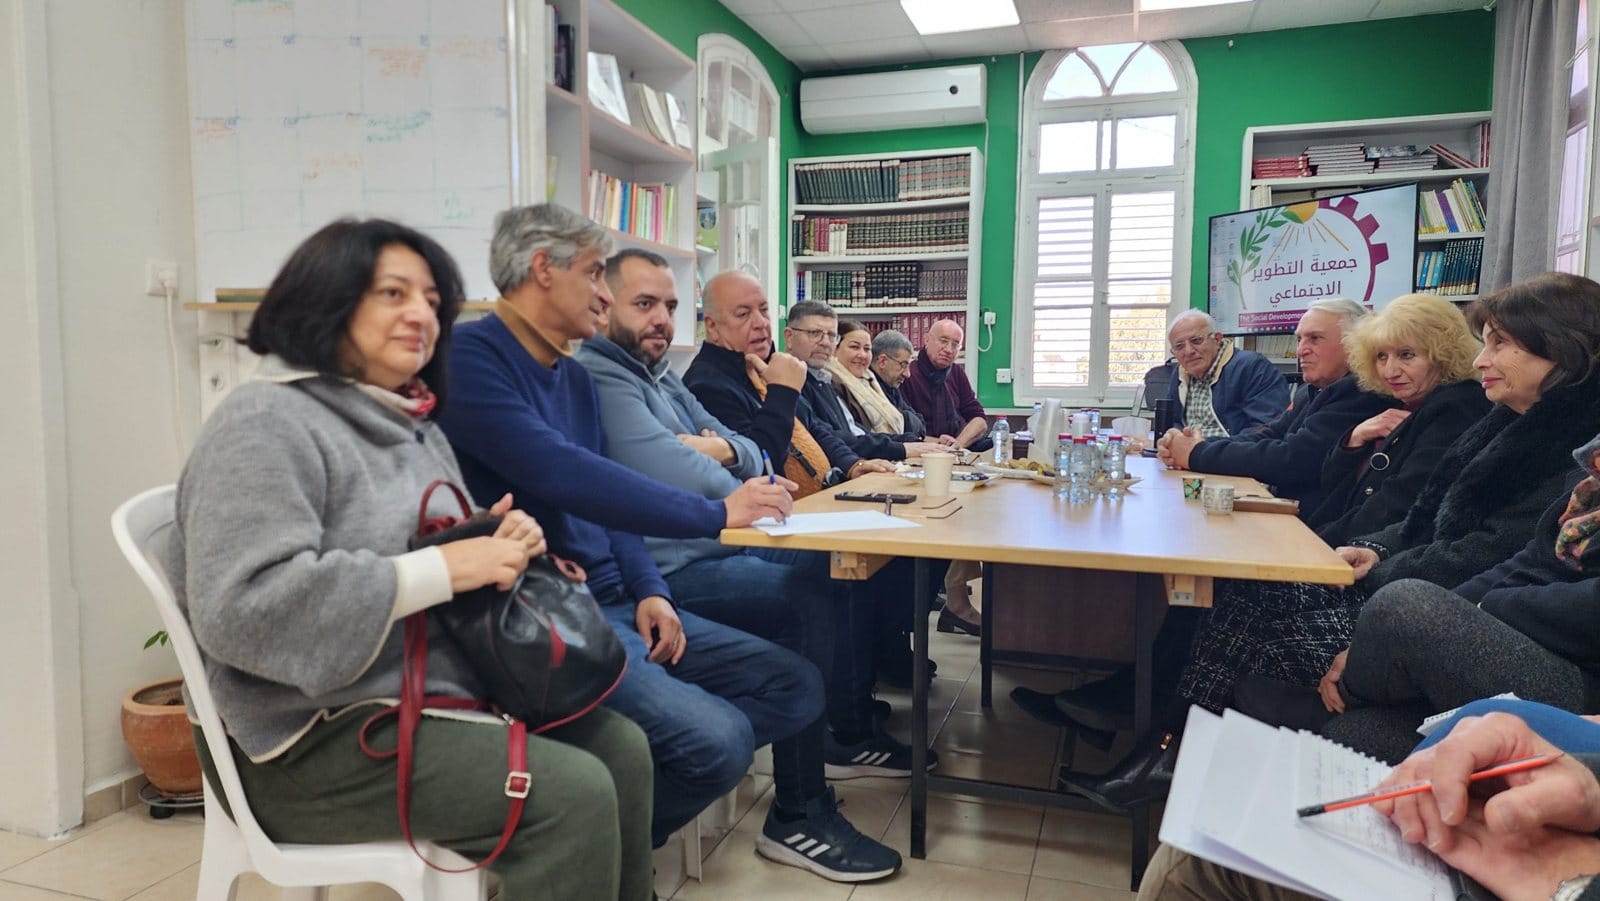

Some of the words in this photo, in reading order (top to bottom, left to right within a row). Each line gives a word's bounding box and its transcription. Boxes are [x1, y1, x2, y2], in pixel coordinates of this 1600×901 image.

[1251, 259, 1303, 282] التطوير
[1310, 257, 1357, 276] جمعية
[1269, 280, 1341, 308] الاجتماعي
[1239, 314, 1250, 322] The
[1250, 313, 1268, 322] Social
[1268, 312, 1304, 321] Developmen
